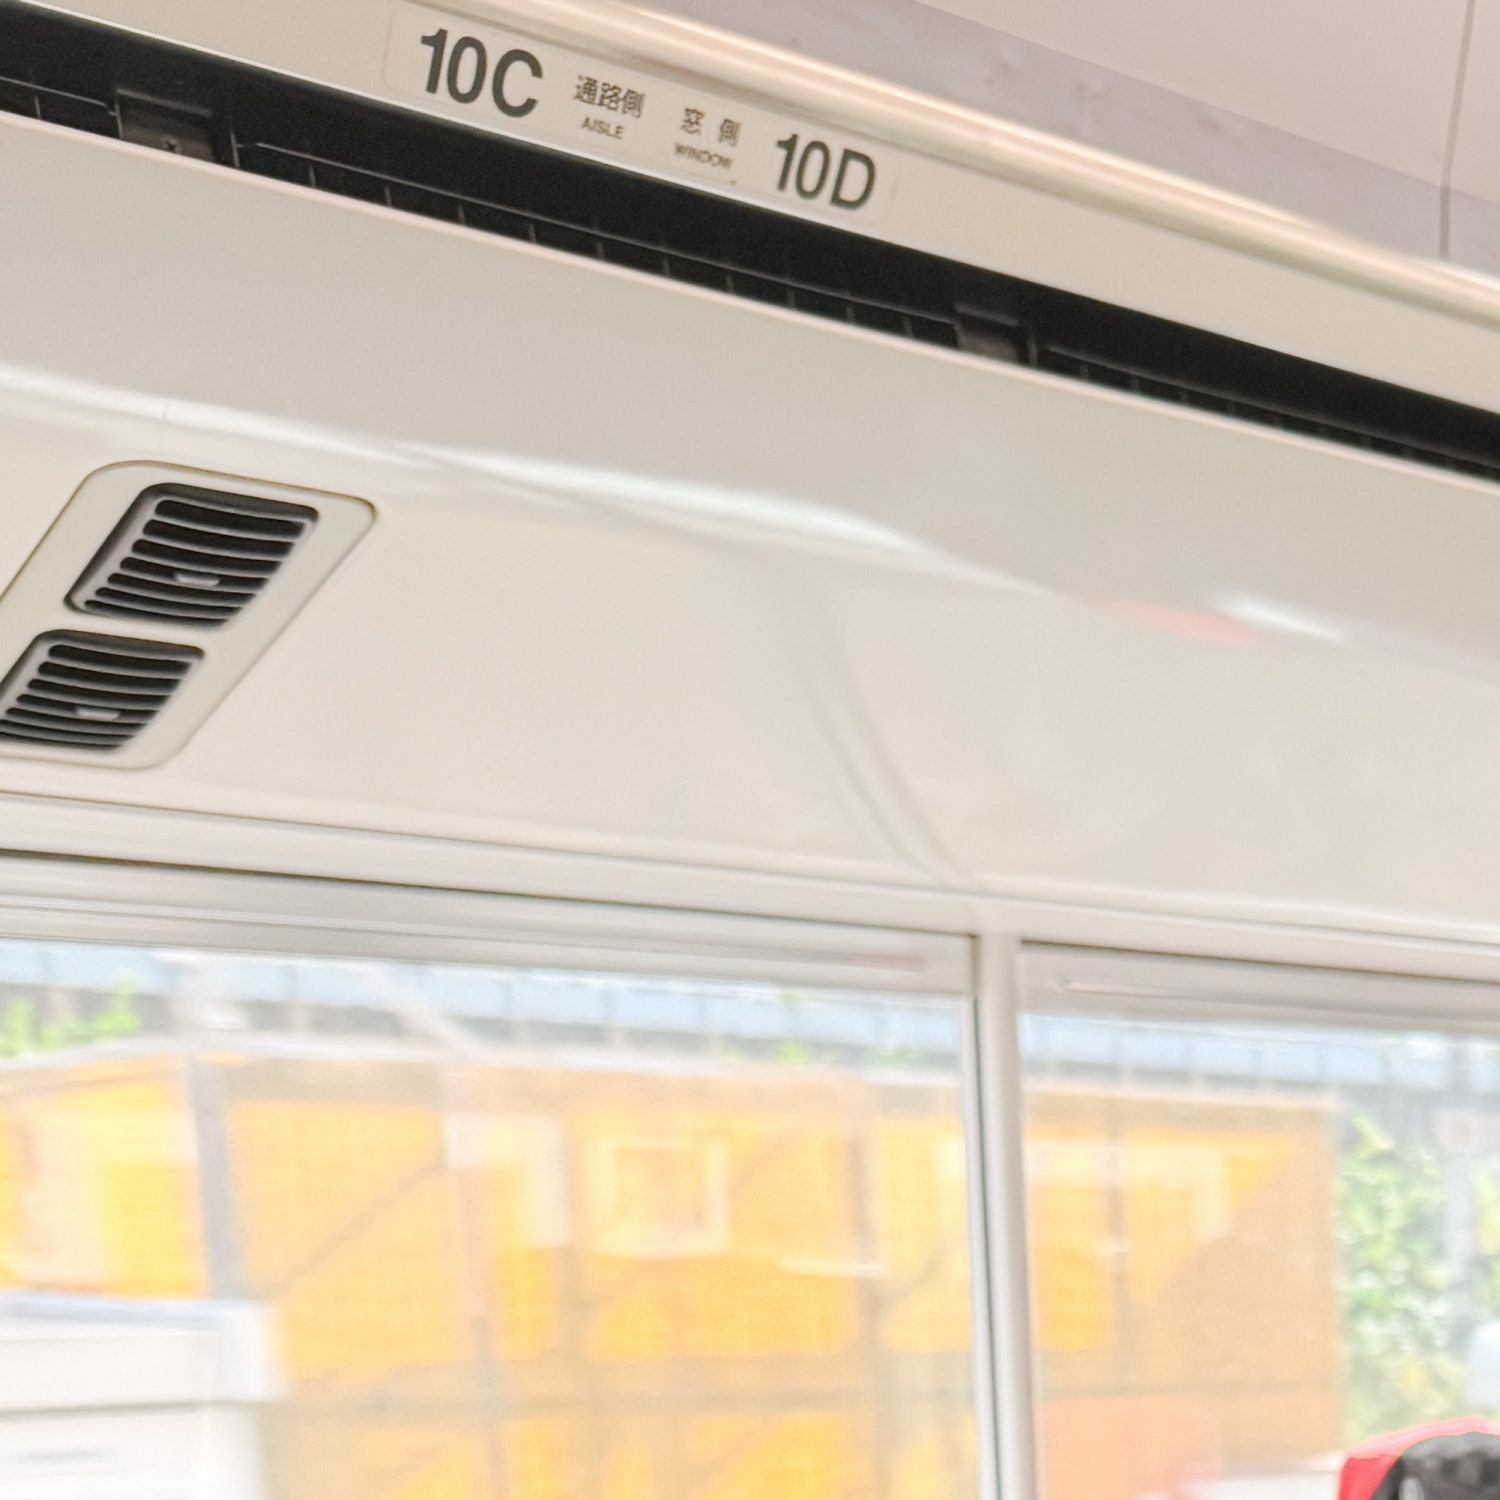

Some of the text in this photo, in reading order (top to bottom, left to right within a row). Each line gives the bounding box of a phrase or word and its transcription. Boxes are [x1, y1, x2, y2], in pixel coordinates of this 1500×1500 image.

[420, 29, 542, 117] 10C
[574, 75, 645, 118] 通路側
[582, 117, 624, 139] AISLE
[675, 143, 733, 168] WINDOW
[775, 134, 876, 210] 10D
